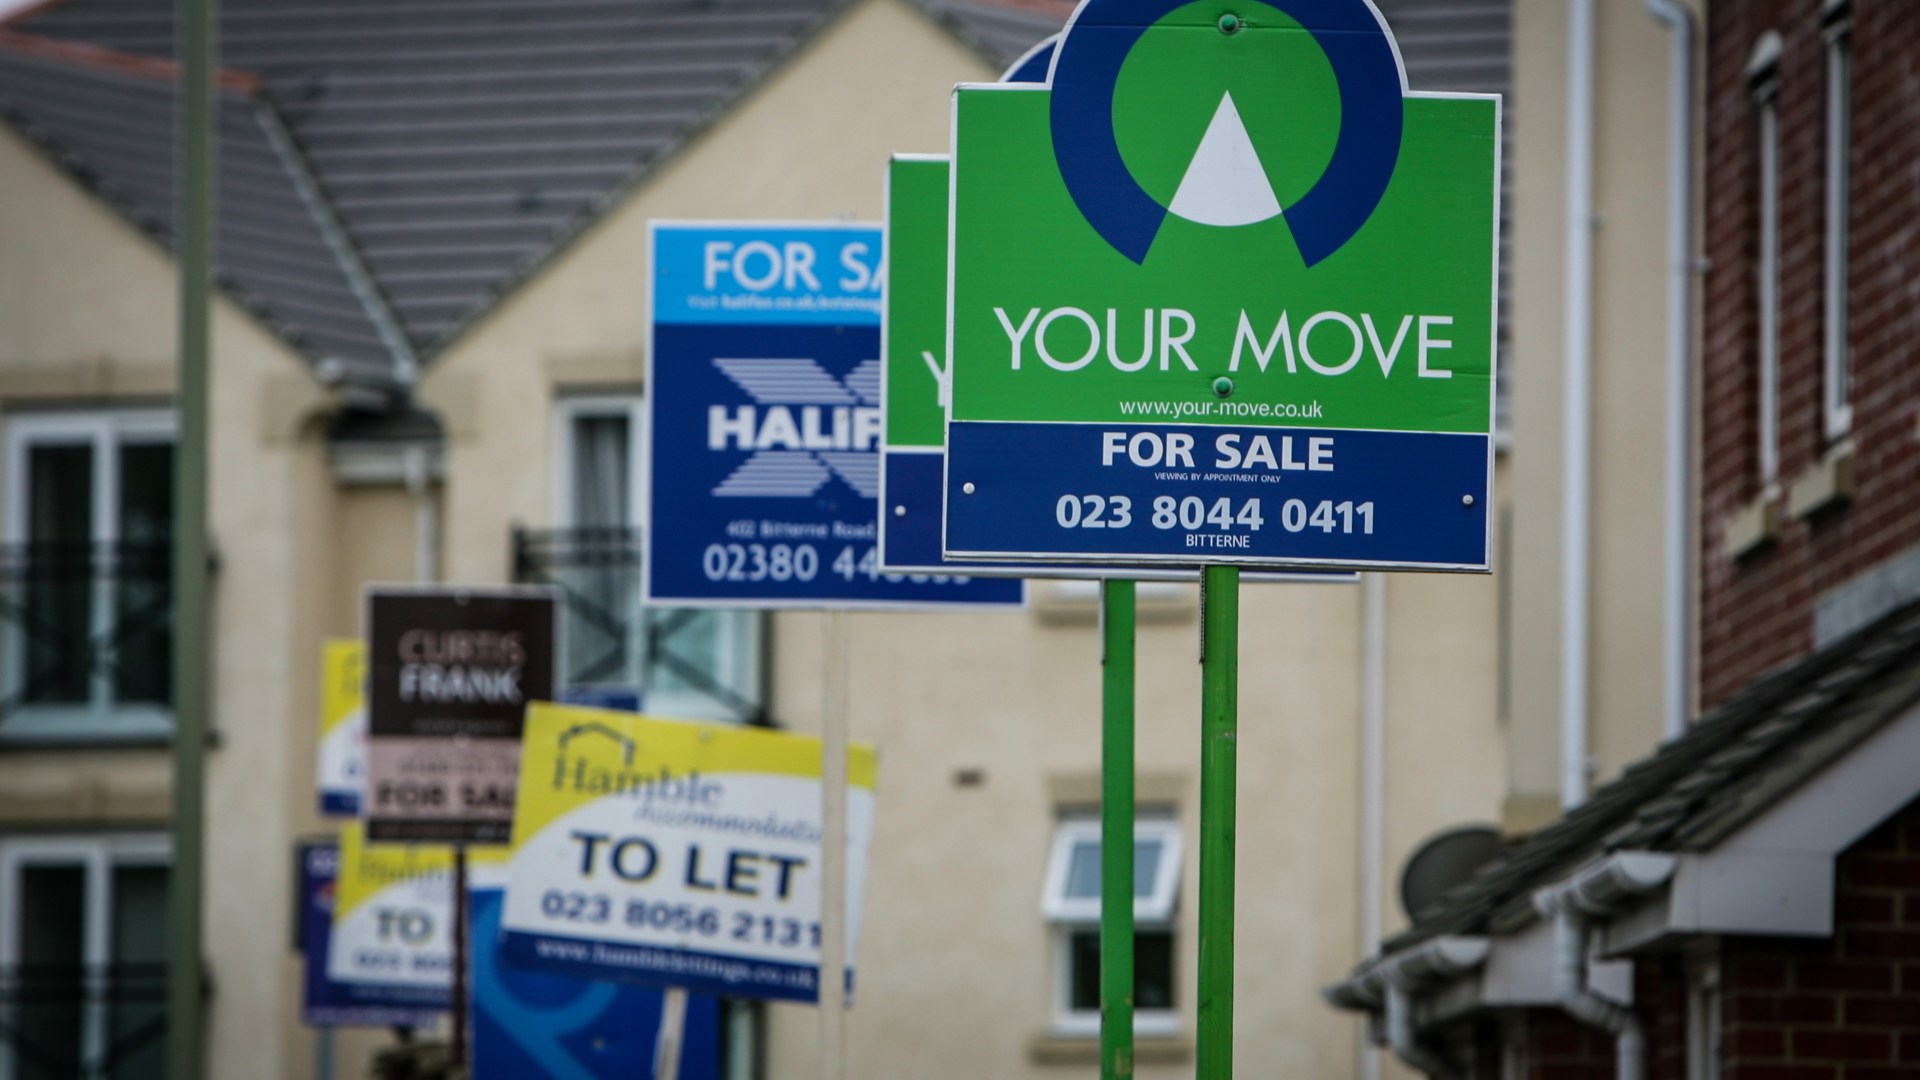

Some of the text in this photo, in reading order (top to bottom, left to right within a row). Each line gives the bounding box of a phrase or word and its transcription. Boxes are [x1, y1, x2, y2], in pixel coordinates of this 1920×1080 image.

[703, 241, 881, 292] FOR S
[993, 306, 1454, 379] YOUR MOVE
[1119, 399, 1323, 419] www.your-move.co.uk
[1101, 431, 1335, 472] FOR SALE
[1154, 472, 1282, 484] VIEWING BY APPOINTMENT ONLY
[1055, 494, 1374, 534] 023 8044 0411
[1185, 533, 1251, 549] BITTERNE
[702, 543, 819, 582] 02380
[398, 628, 527, 666] CURTIS
[399, 662, 524, 704] FRANK
[377, 780, 446, 810] FOR
[570, 829, 808, 902] TO LET
[376, 905, 436, 948] TO
[541, 887, 820, 950] 023 8056 2131
